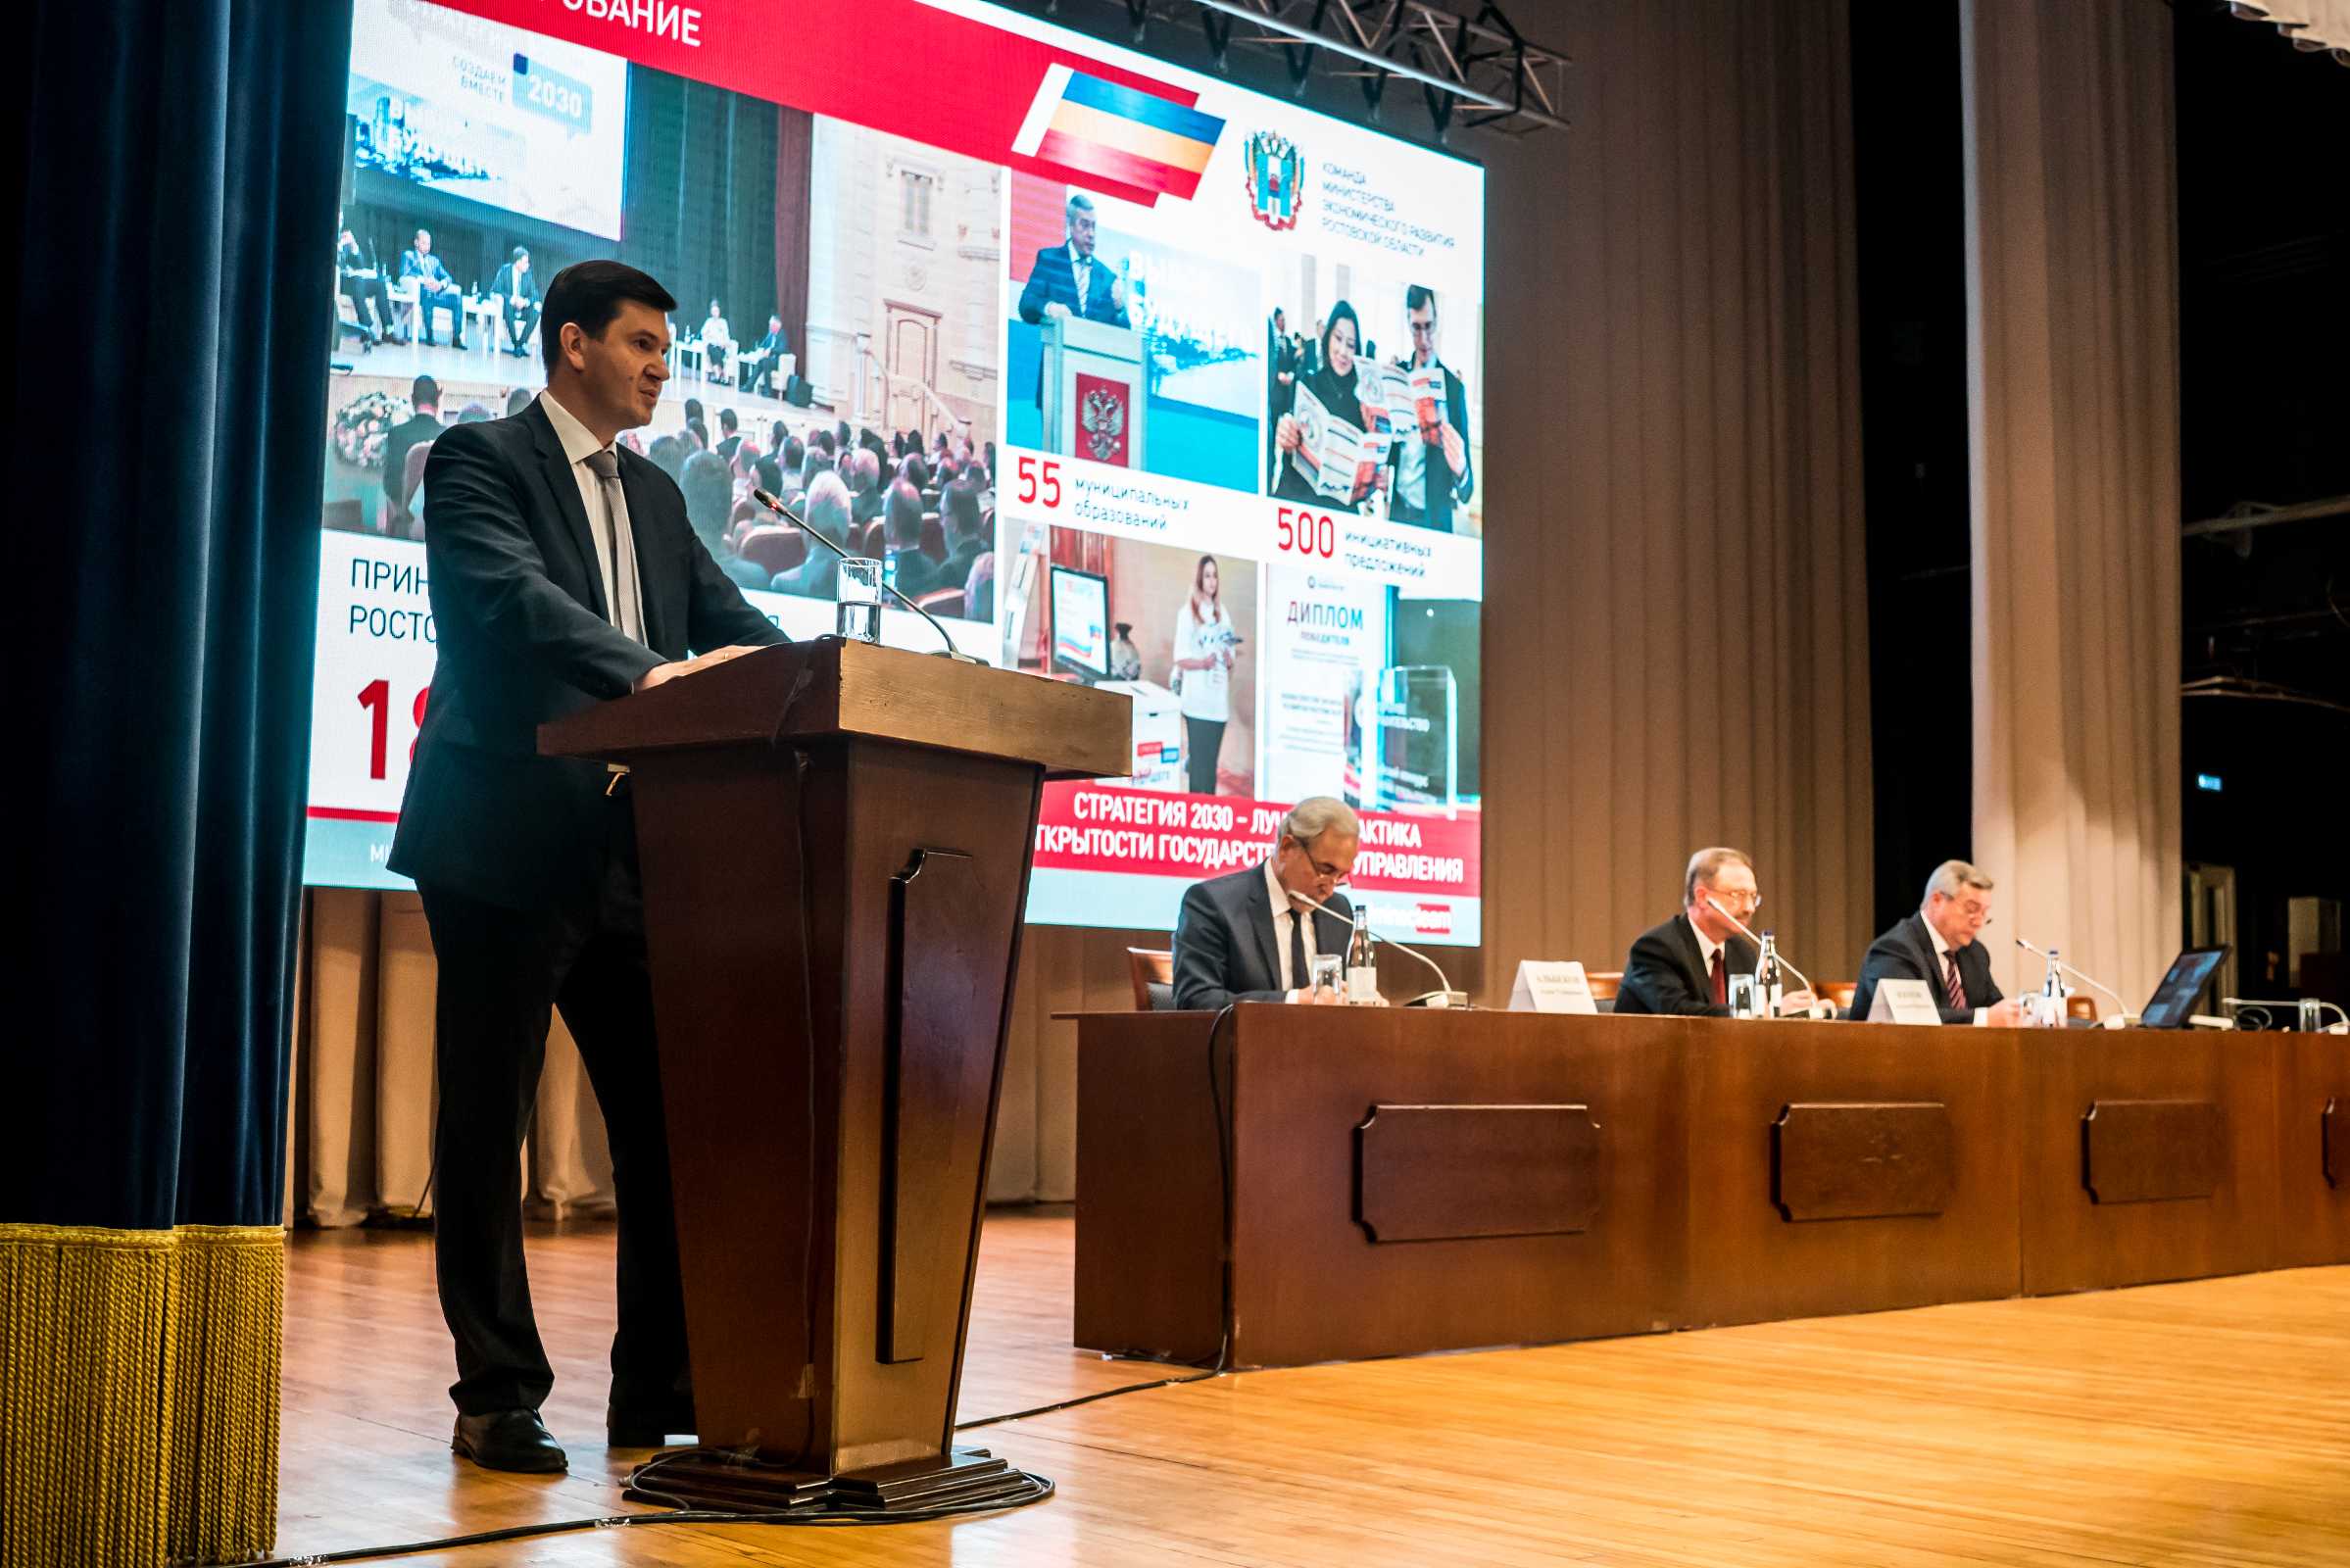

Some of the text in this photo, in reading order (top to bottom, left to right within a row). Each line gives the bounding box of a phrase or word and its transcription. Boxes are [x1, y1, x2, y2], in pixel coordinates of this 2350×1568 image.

[563, 0, 702, 47] АНИЕ
[529, 74, 583, 118] 2030
[1018, 456, 1061, 509] 55
[1075, 478, 1190, 513] муниципальных
[1074, 500, 1169, 530] образований
[1278, 507, 1335, 559] 500
[1345, 532, 1432, 558] инициативных
[1345, 553, 1427, 577] предложений
[1288, 601, 1363, 630] ДИПЛОМ
[1074, 792, 1187, 828] СТРАТЕГИЯ
[1191, 802, 1234, 831] 2030
[1035, 824, 1154, 860] ТКРЫТОСТИ
[1352, 851, 1464, 884] УПРАВЛЕНИЯ
